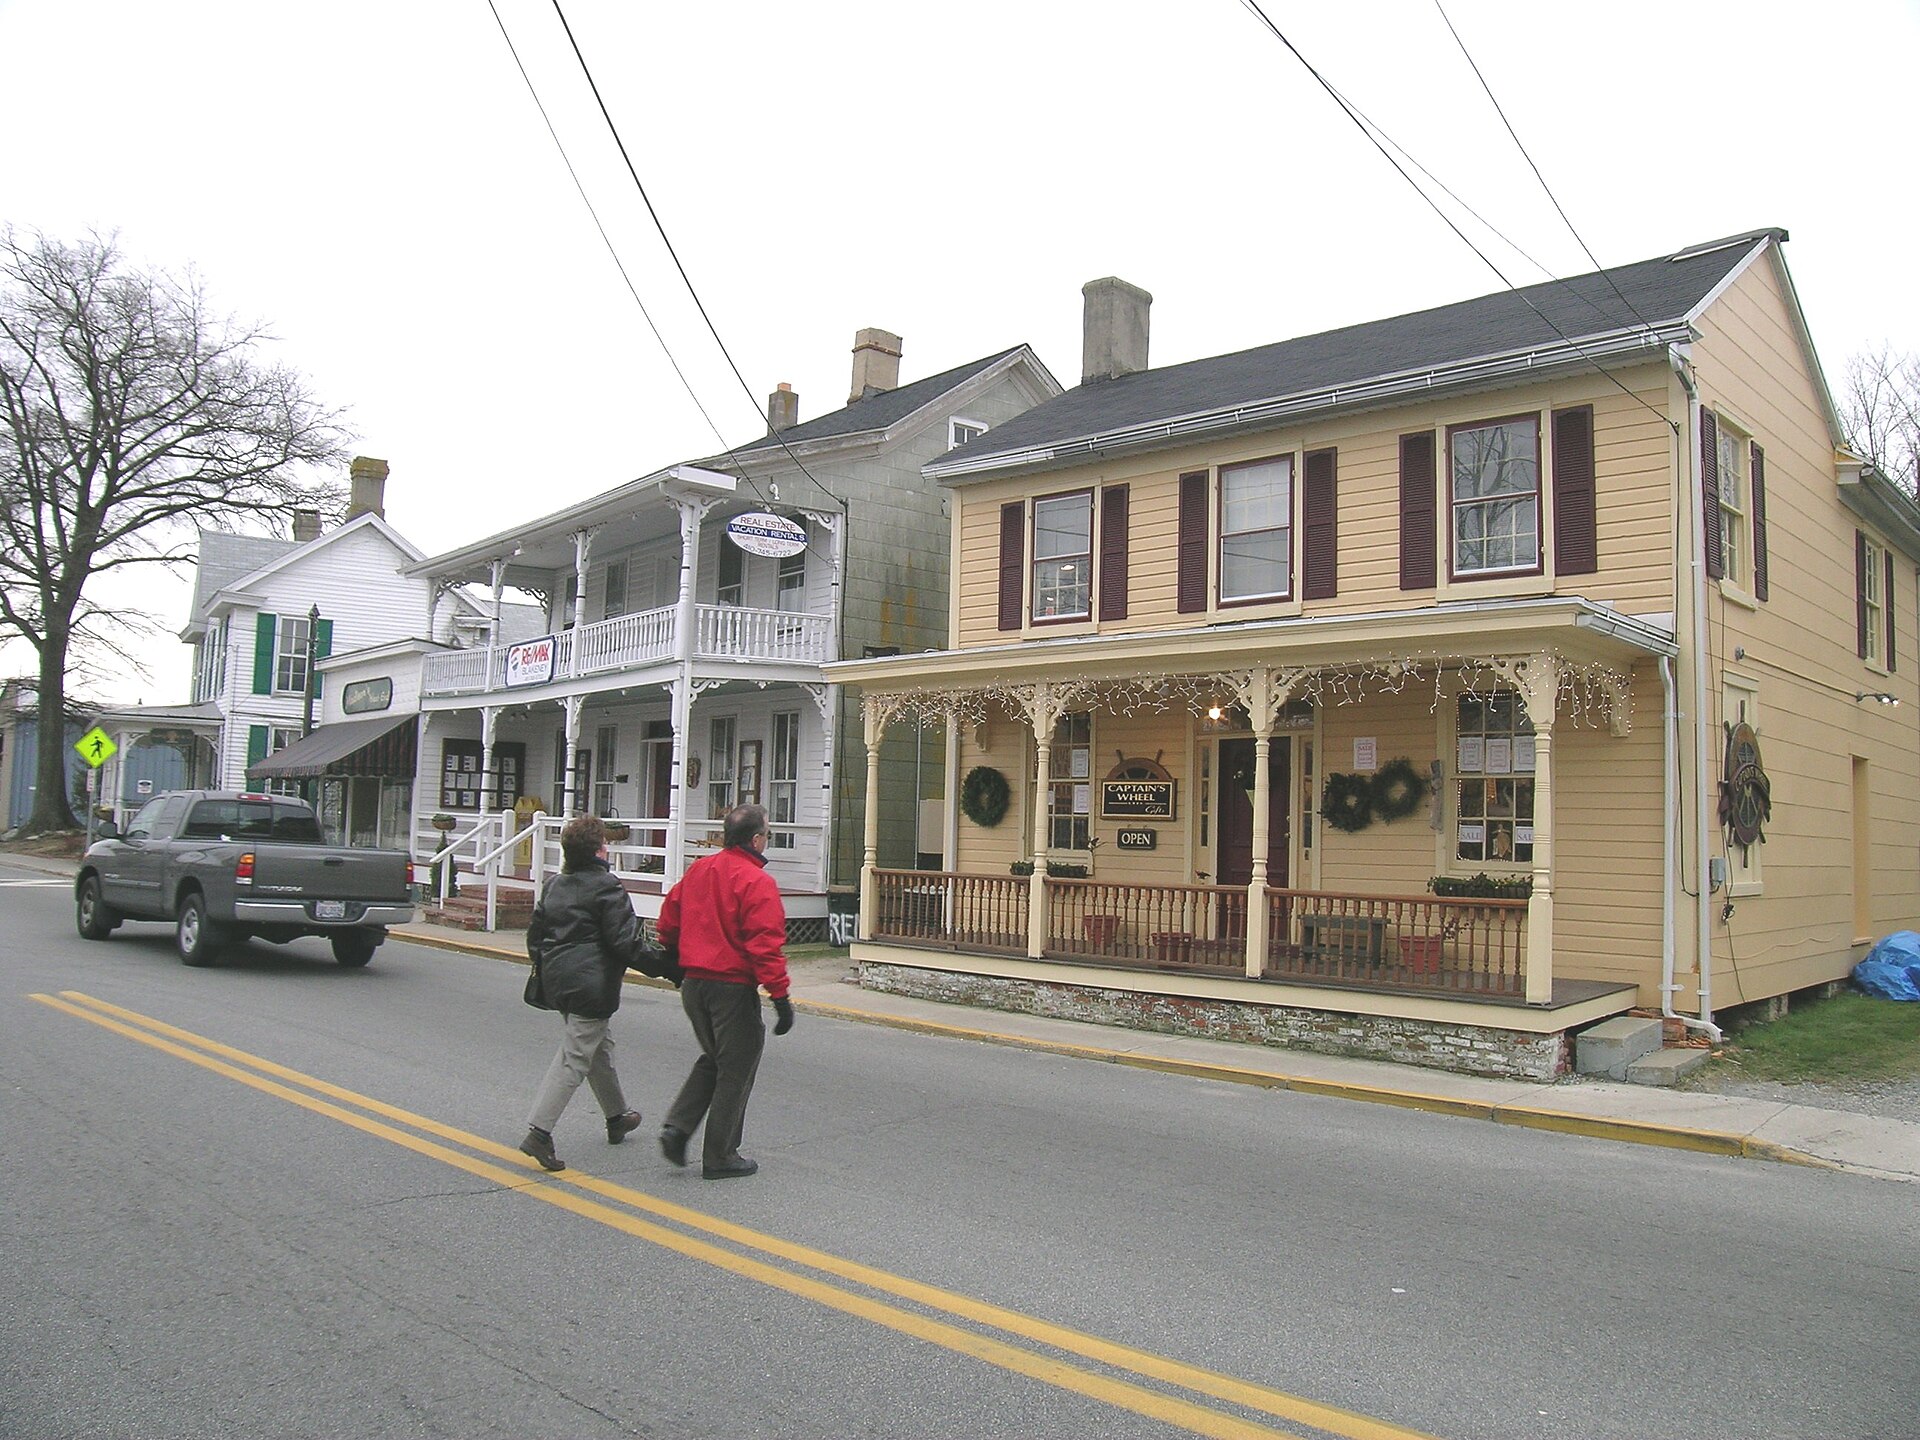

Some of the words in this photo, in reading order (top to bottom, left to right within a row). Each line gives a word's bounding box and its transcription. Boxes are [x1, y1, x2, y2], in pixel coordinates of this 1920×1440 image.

[740, 516, 764, 527] REAL
[765, 520, 796, 531] ESTATE
[731, 524, 768, 536] VACATION
[771, 531, 805, 541] RENTALS
[521, 643, 550, 666] RE/MAX
[1108, 784, 1166, 793] CAPTAIN'S
[1117, 793, 1155, 801] WHEEL
[1121, 832, 1151, 845] OPEN
[1460, 832, 1481, 840] SALE
[1518, 833, 1533, 841] SAL
[829, 912, 860, 945] RE
